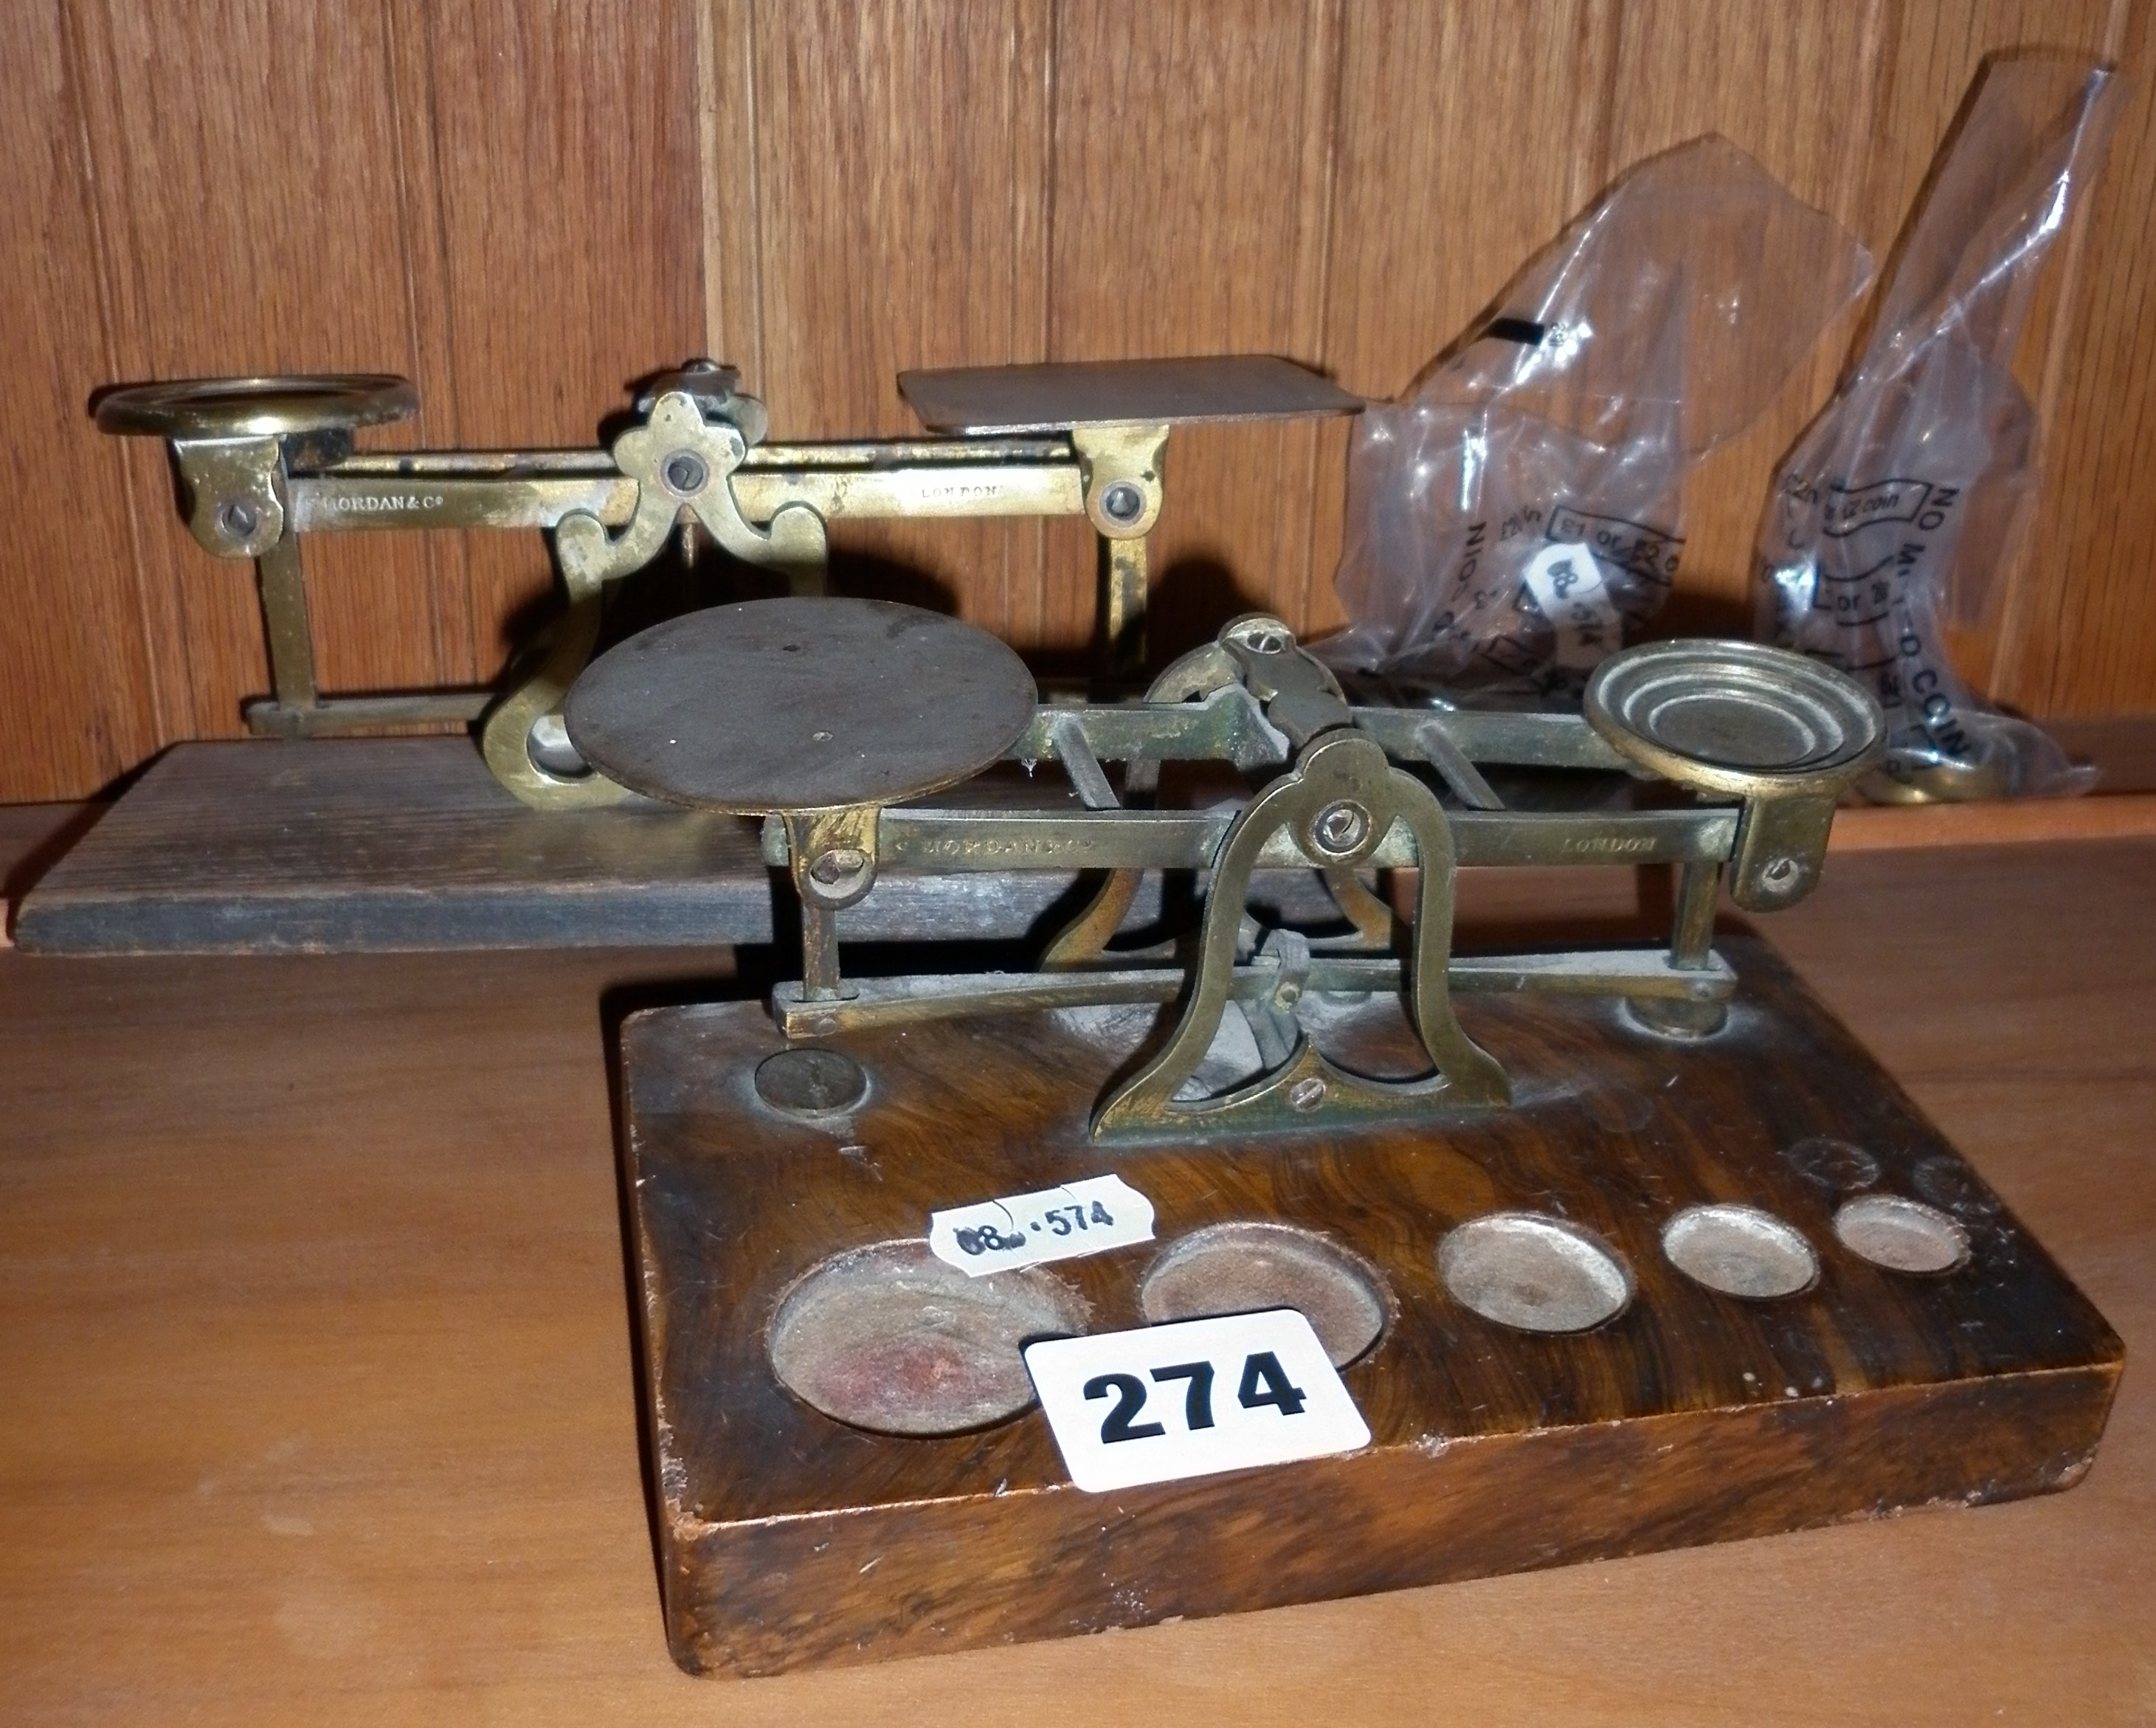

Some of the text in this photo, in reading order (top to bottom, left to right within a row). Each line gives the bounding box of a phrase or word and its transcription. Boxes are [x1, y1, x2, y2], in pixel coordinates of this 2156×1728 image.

[921, 485, 998, 499] LONDON
[1918, 487, 1960, 531] NO
[1561, 837, 1658, 853] LONDON
[1082, 1350, 1308, 1445] 274
